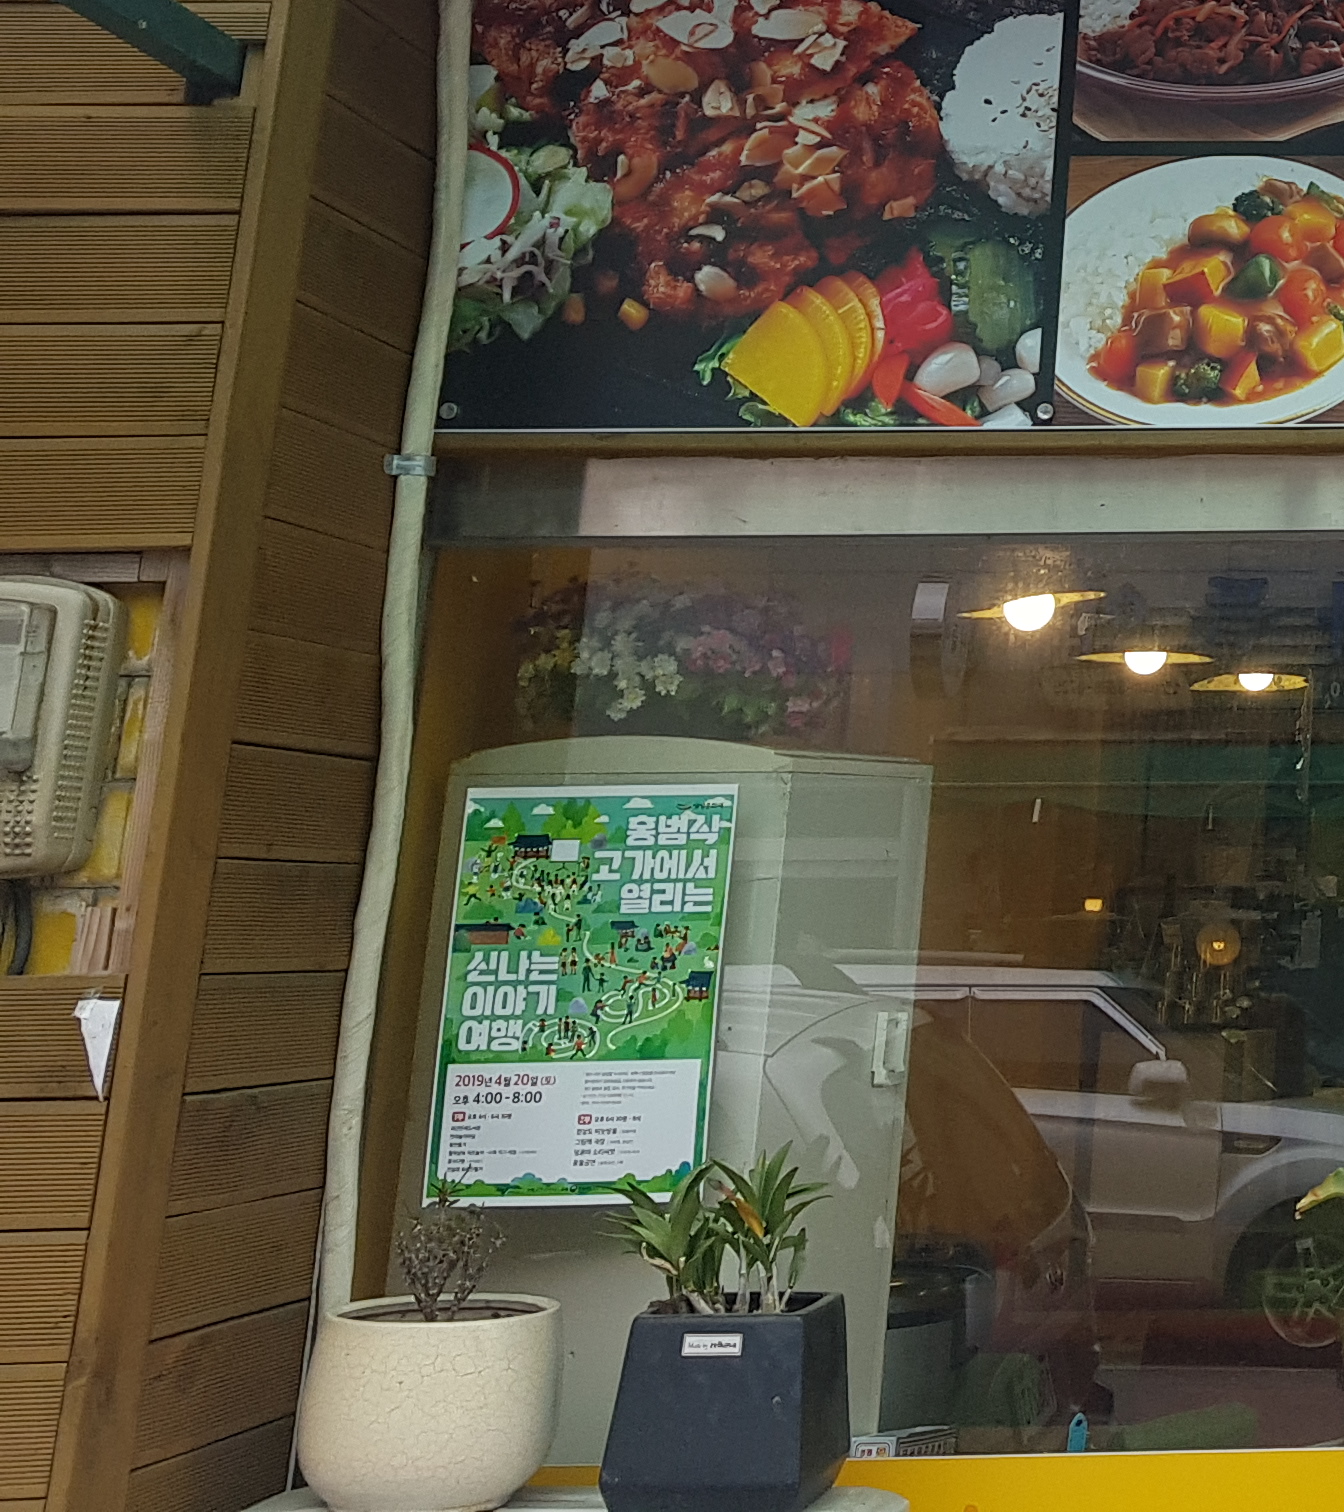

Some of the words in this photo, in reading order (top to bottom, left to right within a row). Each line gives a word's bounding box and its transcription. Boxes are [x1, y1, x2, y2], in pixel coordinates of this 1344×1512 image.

[626, 814, 720, 846] 홍범식
[592, 849, 717, 880] 고가에서
[619, 882, 714, 914] 열리는
[467, 950, 559, 982] 신나는
[462, 984, 557, 1016] 이야기
[457, 1019, 523, 1051] 여행
